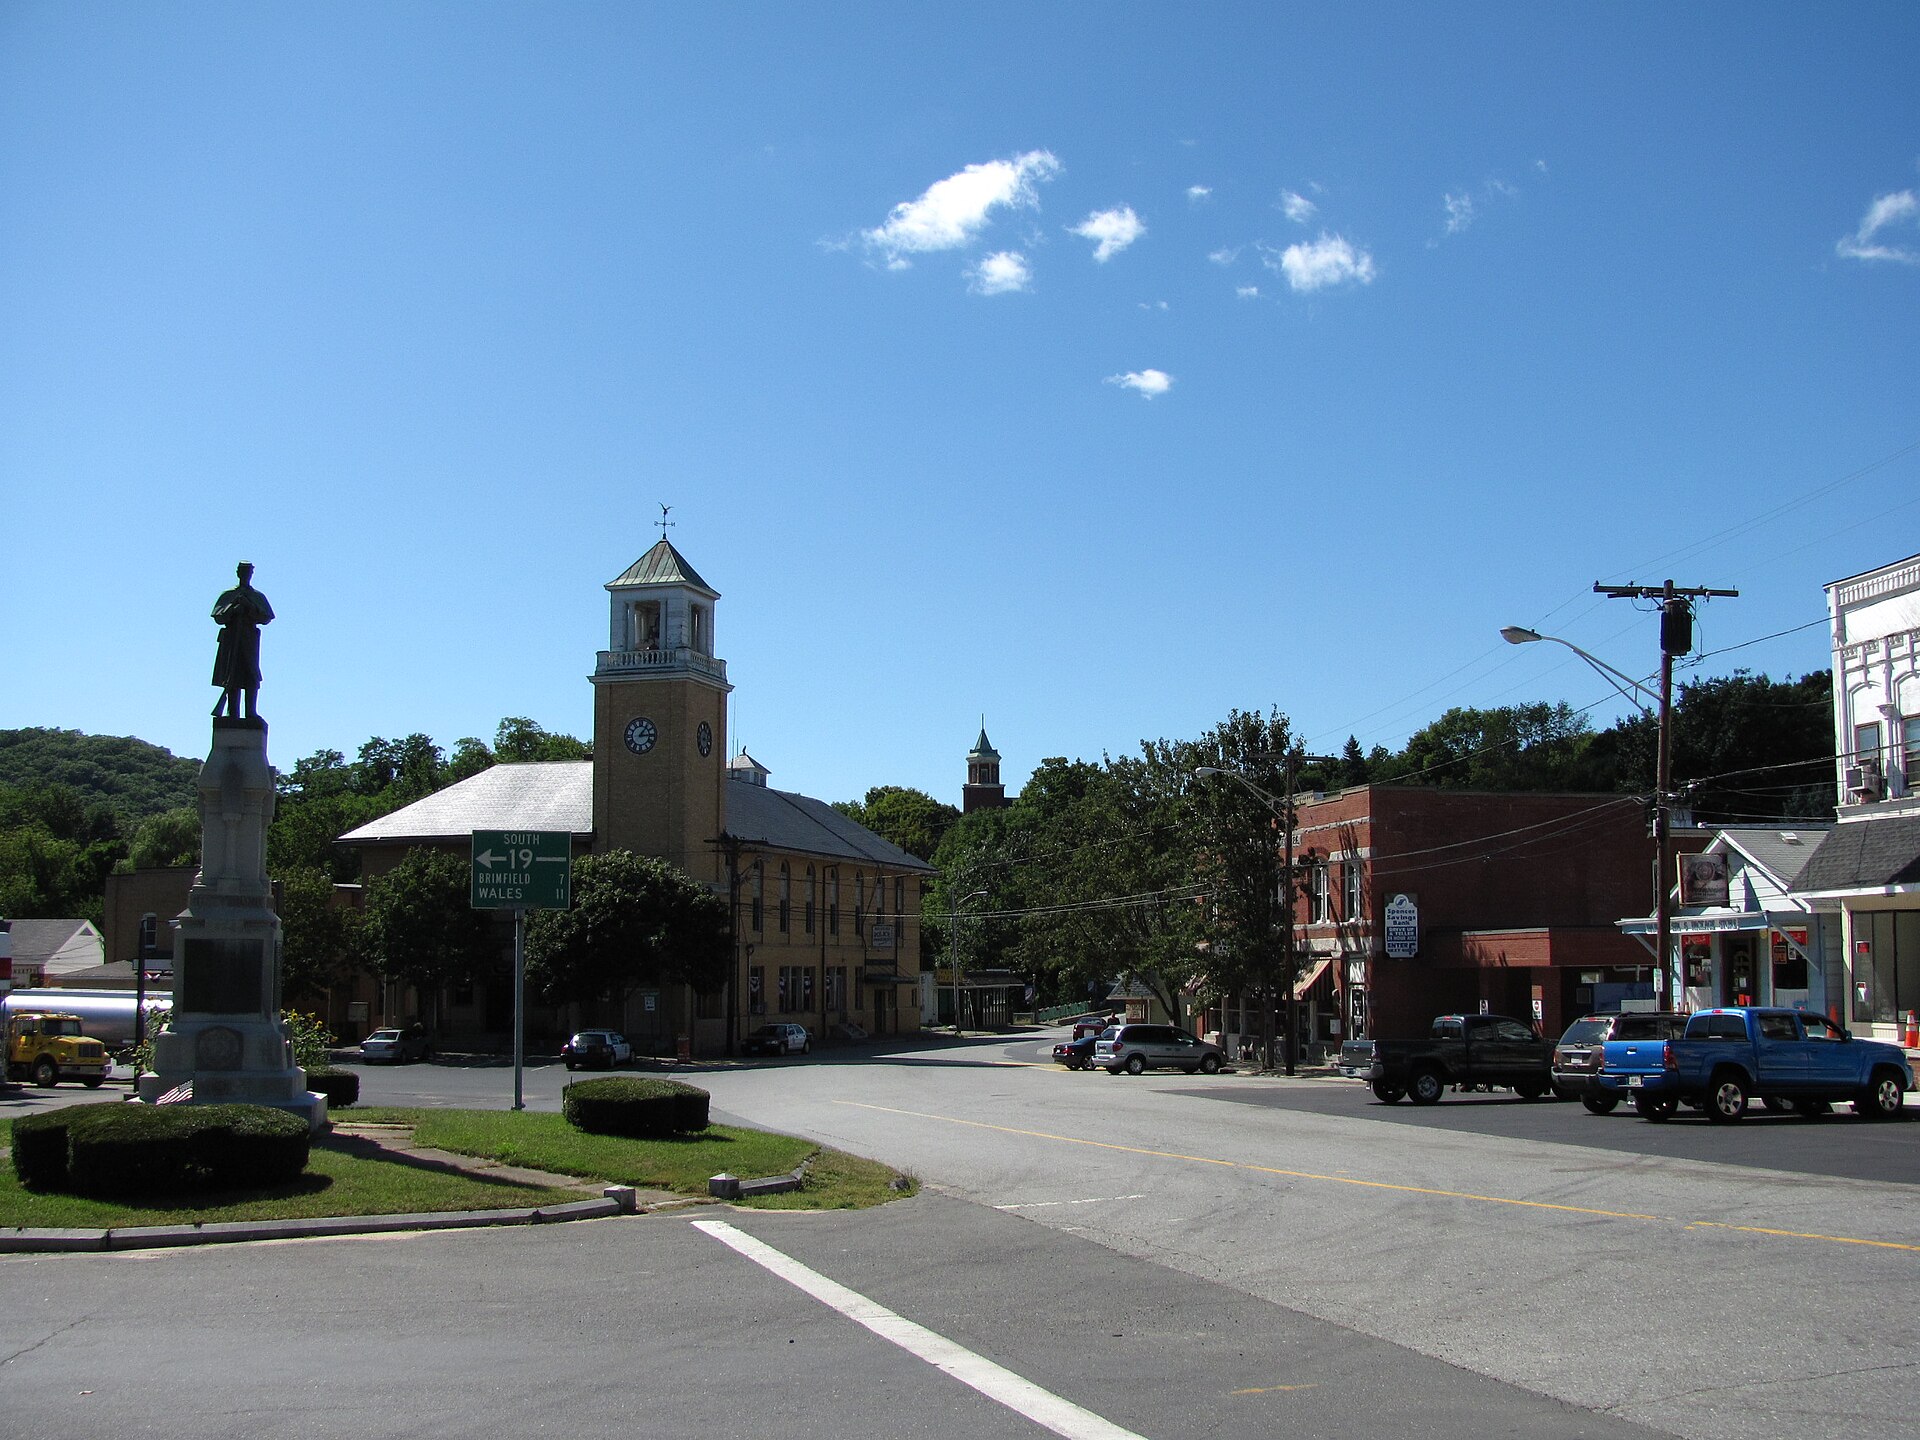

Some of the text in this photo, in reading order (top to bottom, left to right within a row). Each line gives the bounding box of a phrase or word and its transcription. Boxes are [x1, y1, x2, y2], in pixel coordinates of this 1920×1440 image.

[504, 834, 540, 844] SOUTH
[510, 848, 532, 869] 19
[480, 873, 564, 884] BRIMFIELD 7
[480, 888, 564, 900] WALES 11
